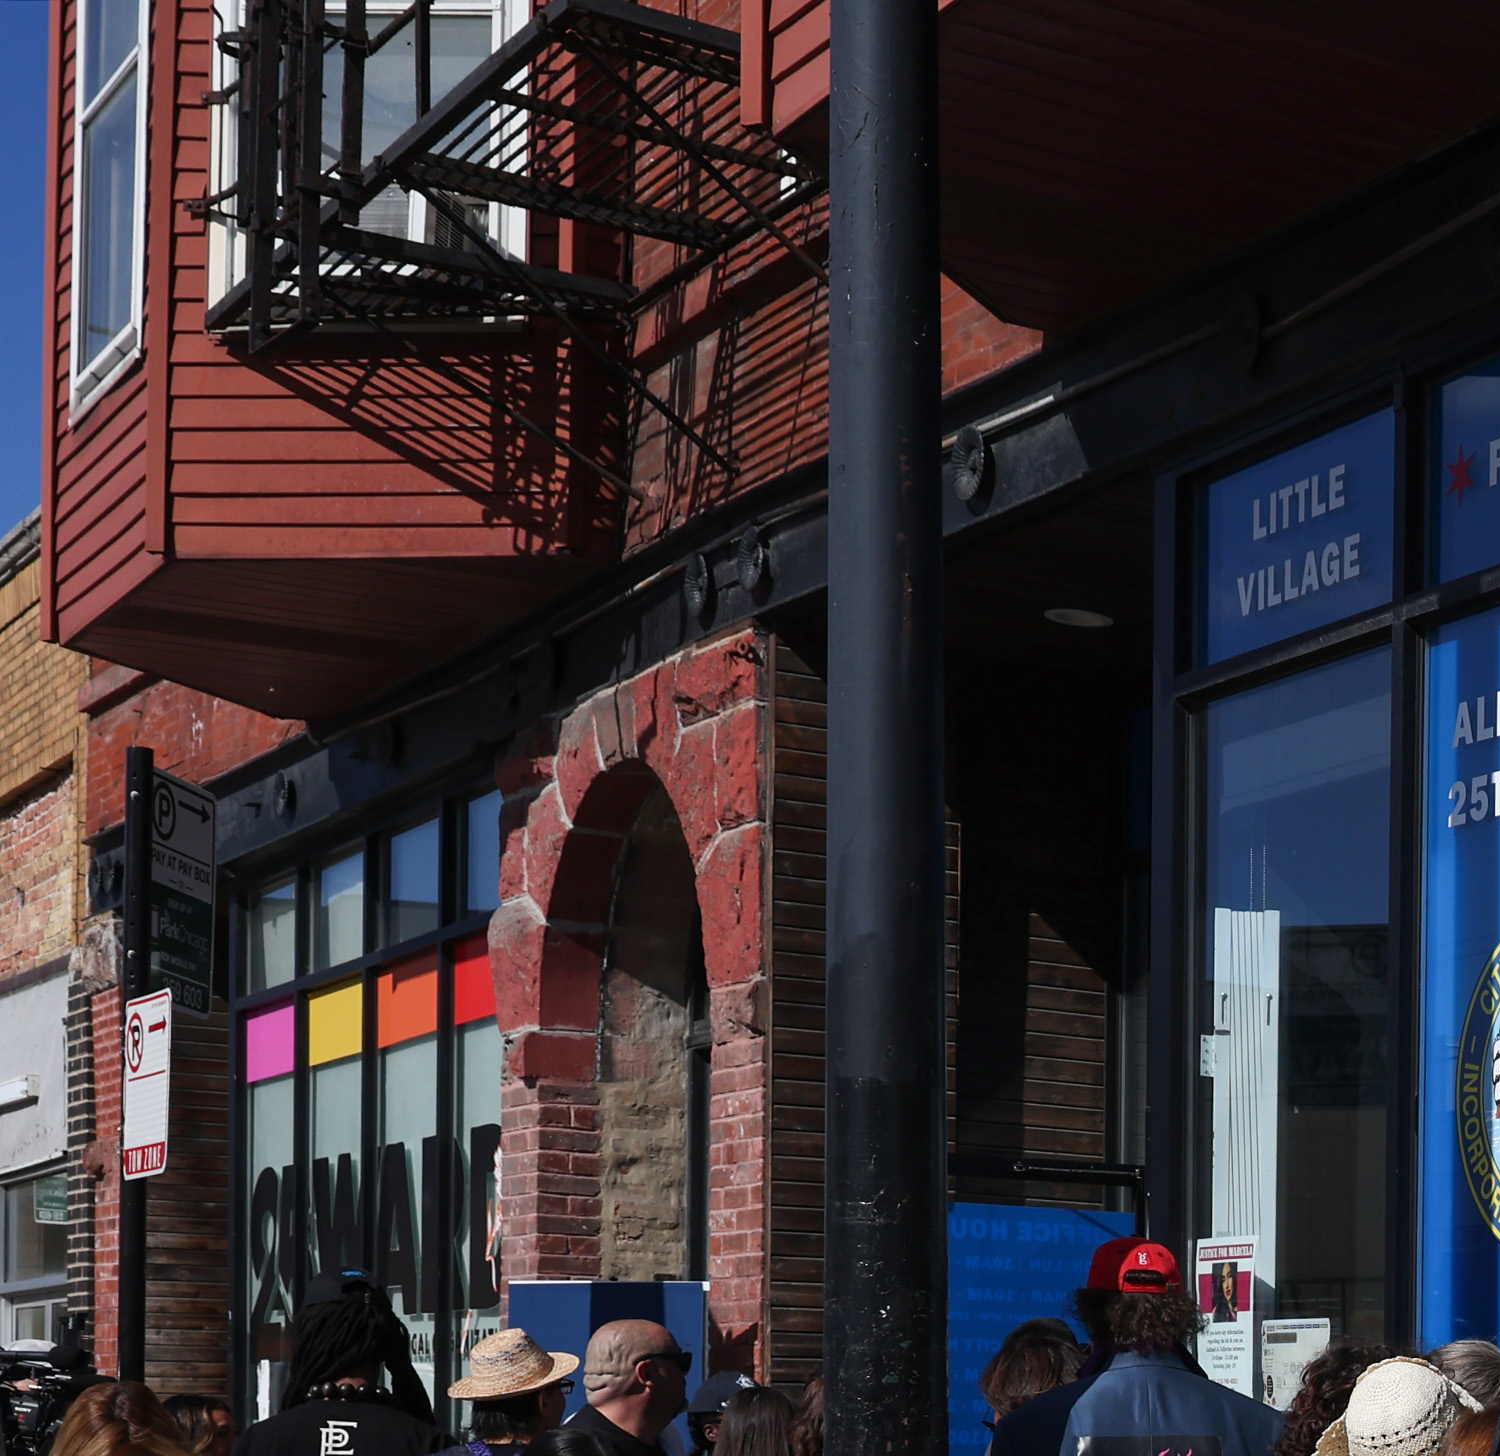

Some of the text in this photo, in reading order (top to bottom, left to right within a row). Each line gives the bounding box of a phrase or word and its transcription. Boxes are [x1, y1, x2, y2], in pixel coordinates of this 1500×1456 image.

[1252, 463, 1346, 541] LITTLE
[1237, 532, 1362, 618] VILLAGE
[166, 854, 177, 871] AT
[178, 859, 194, 879] PAY
[194, 868, 211, 886] BOX
[183, 984, 202, 1009] 603
[128, 1145, 162, 1173] TOW ZONE
[1199, 1245, 1253, 1259] JUSTICE FOR MARCELA
